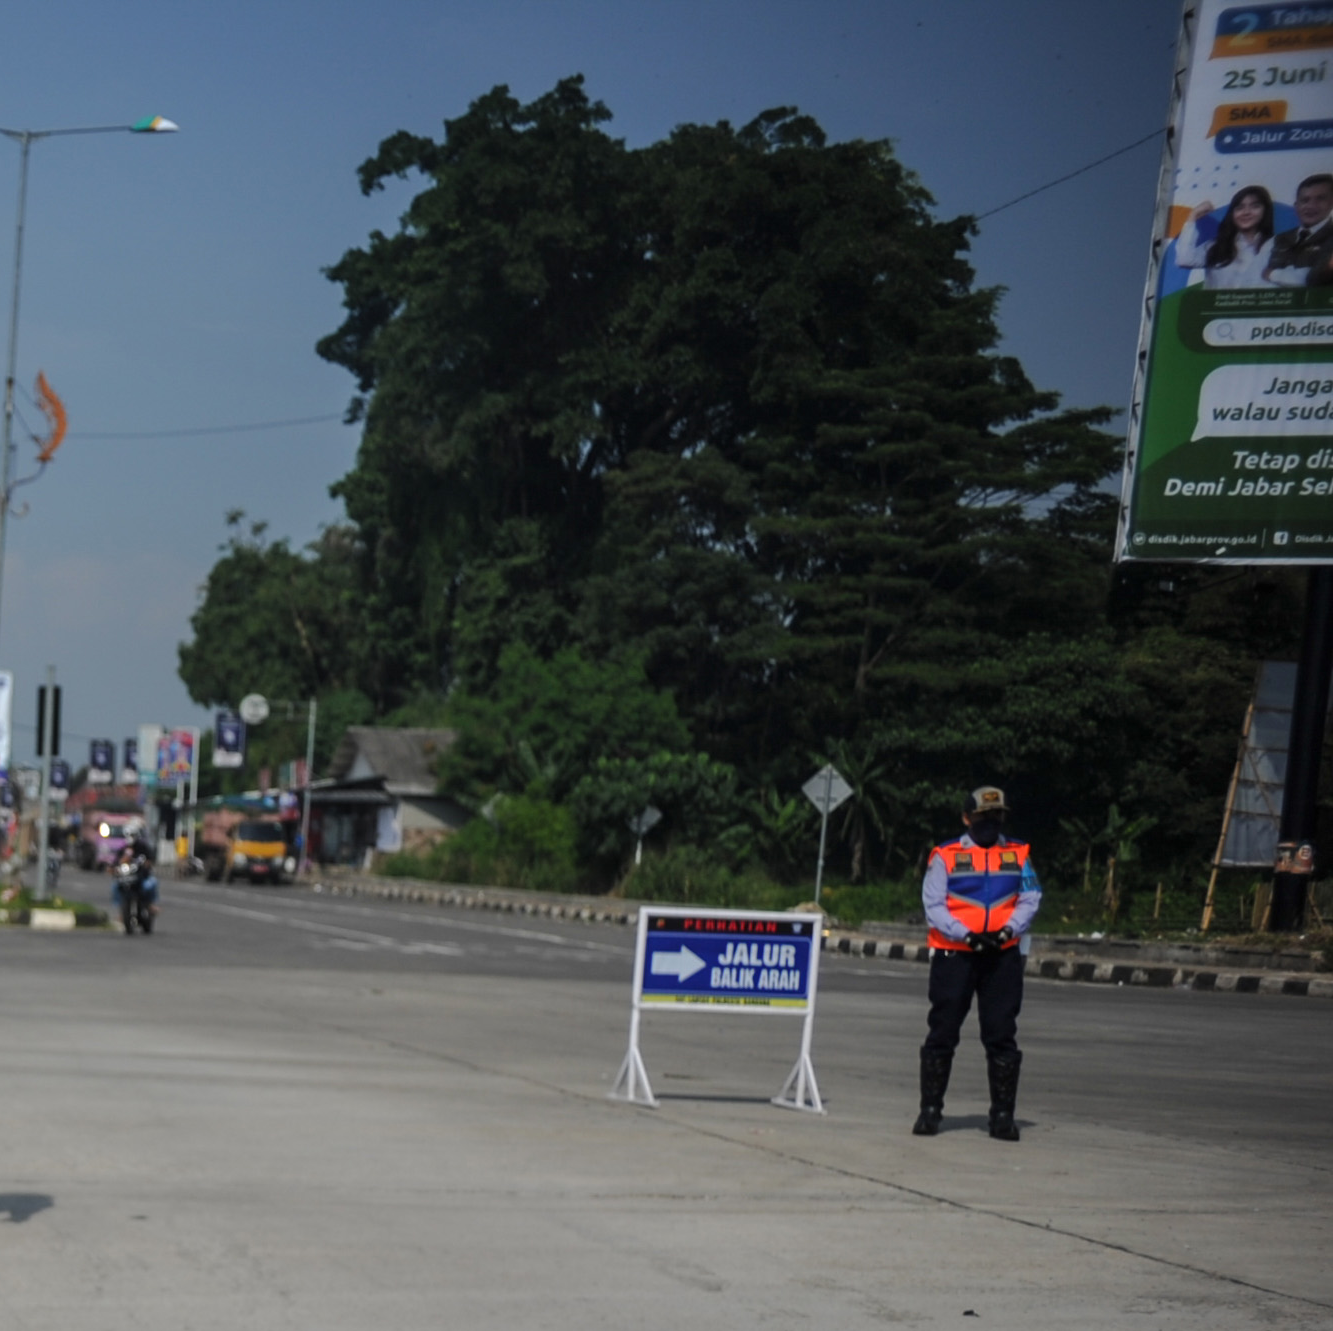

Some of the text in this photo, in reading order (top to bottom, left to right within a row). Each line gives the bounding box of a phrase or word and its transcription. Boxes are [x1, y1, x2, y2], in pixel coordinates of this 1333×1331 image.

[1227, 13, 1260, 47] 2
[1223, 60, 1328, 90] 25 Juni
[1229, 105, 1272, 121] SMA
[1241, 127, 1333, 145] Jalur Zona
[1213, 402, 1280, 421] walau
[1233, 449, 1300, 474] Tetap
[1164, 477, 1224, 497] Demi
[1228, 477, 1295, 497] Jabar
[683, 917, 778, 933] PERHATIAN
[717, 941, 797, 968] JALUR
[710, 966, 801, 991] BALIK ARAH
